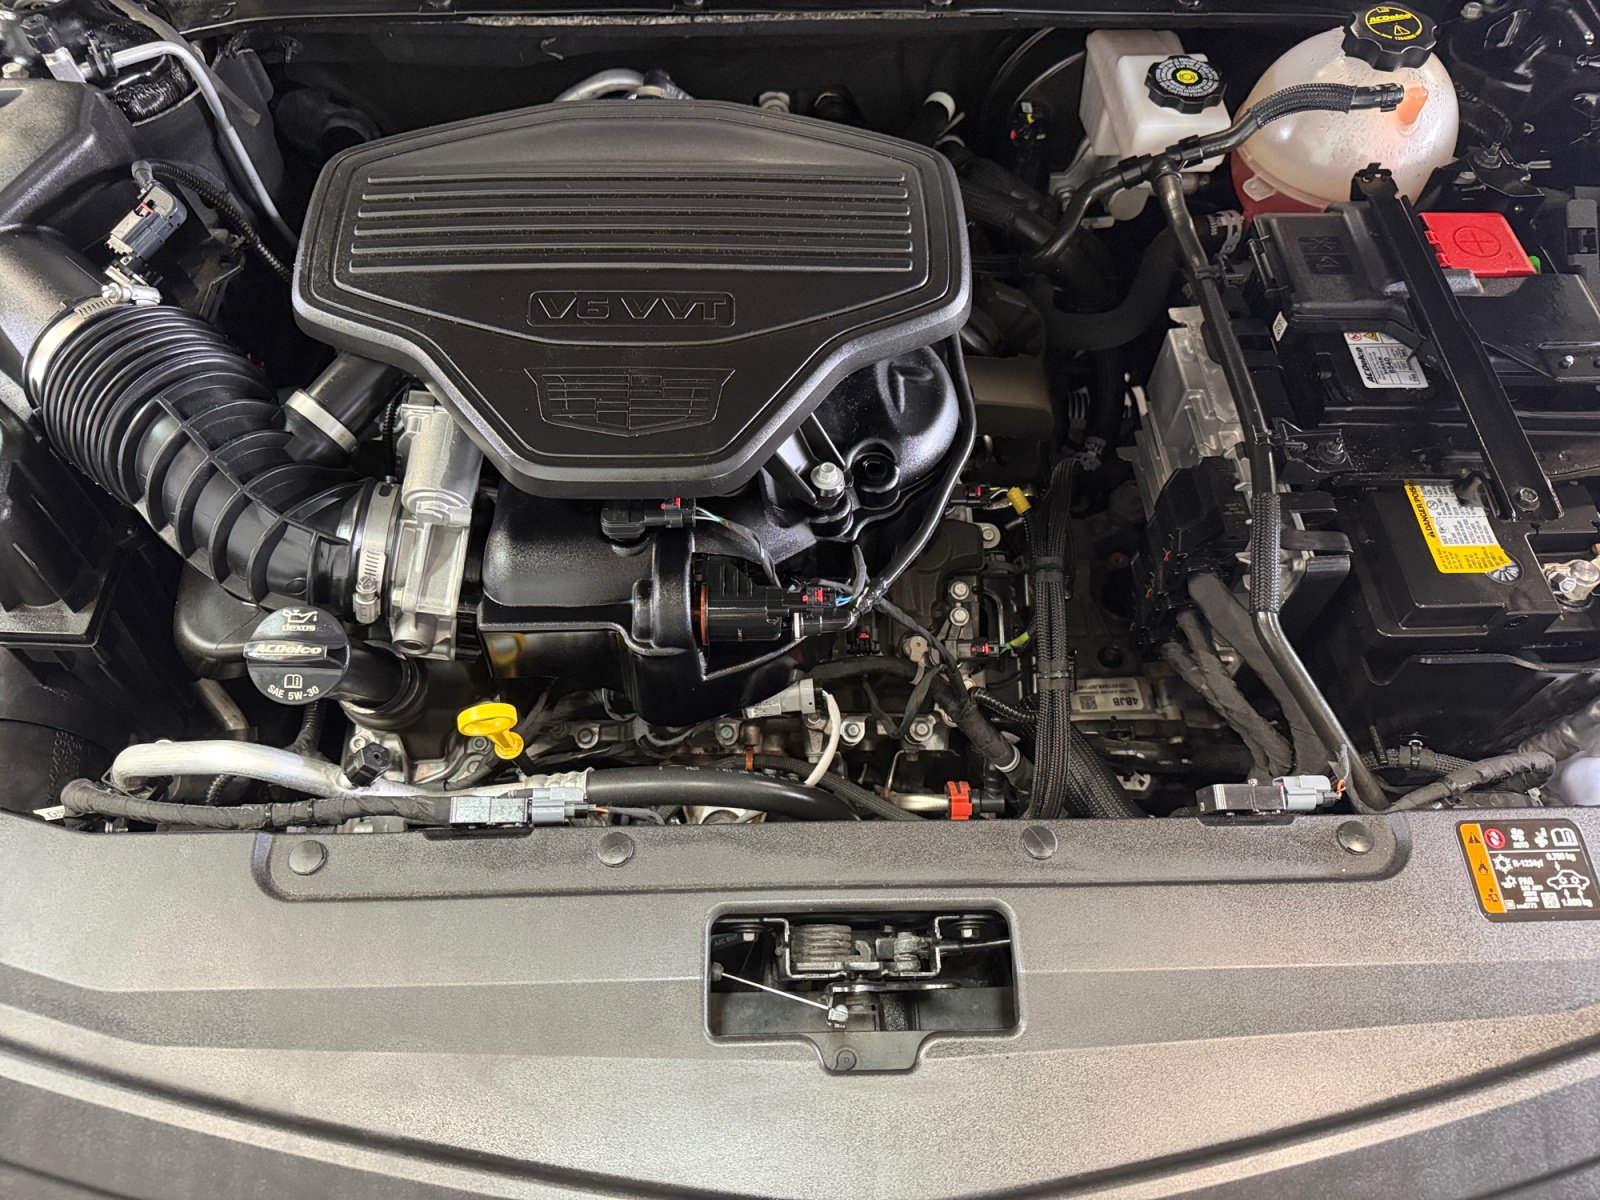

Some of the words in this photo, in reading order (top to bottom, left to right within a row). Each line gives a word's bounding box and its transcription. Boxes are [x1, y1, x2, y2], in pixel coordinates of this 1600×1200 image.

[1369, 14, 1412, 23] ACDelco
[538, 296, 609, 320] V6
[621, 296, 727, 321] VVT
[282, 624, 316, 632] dexos
[255, 644, 322, 655] ACDelco
[267, 684, 285, 698] SAE
[288, 686, 319, 700] 5W-30
